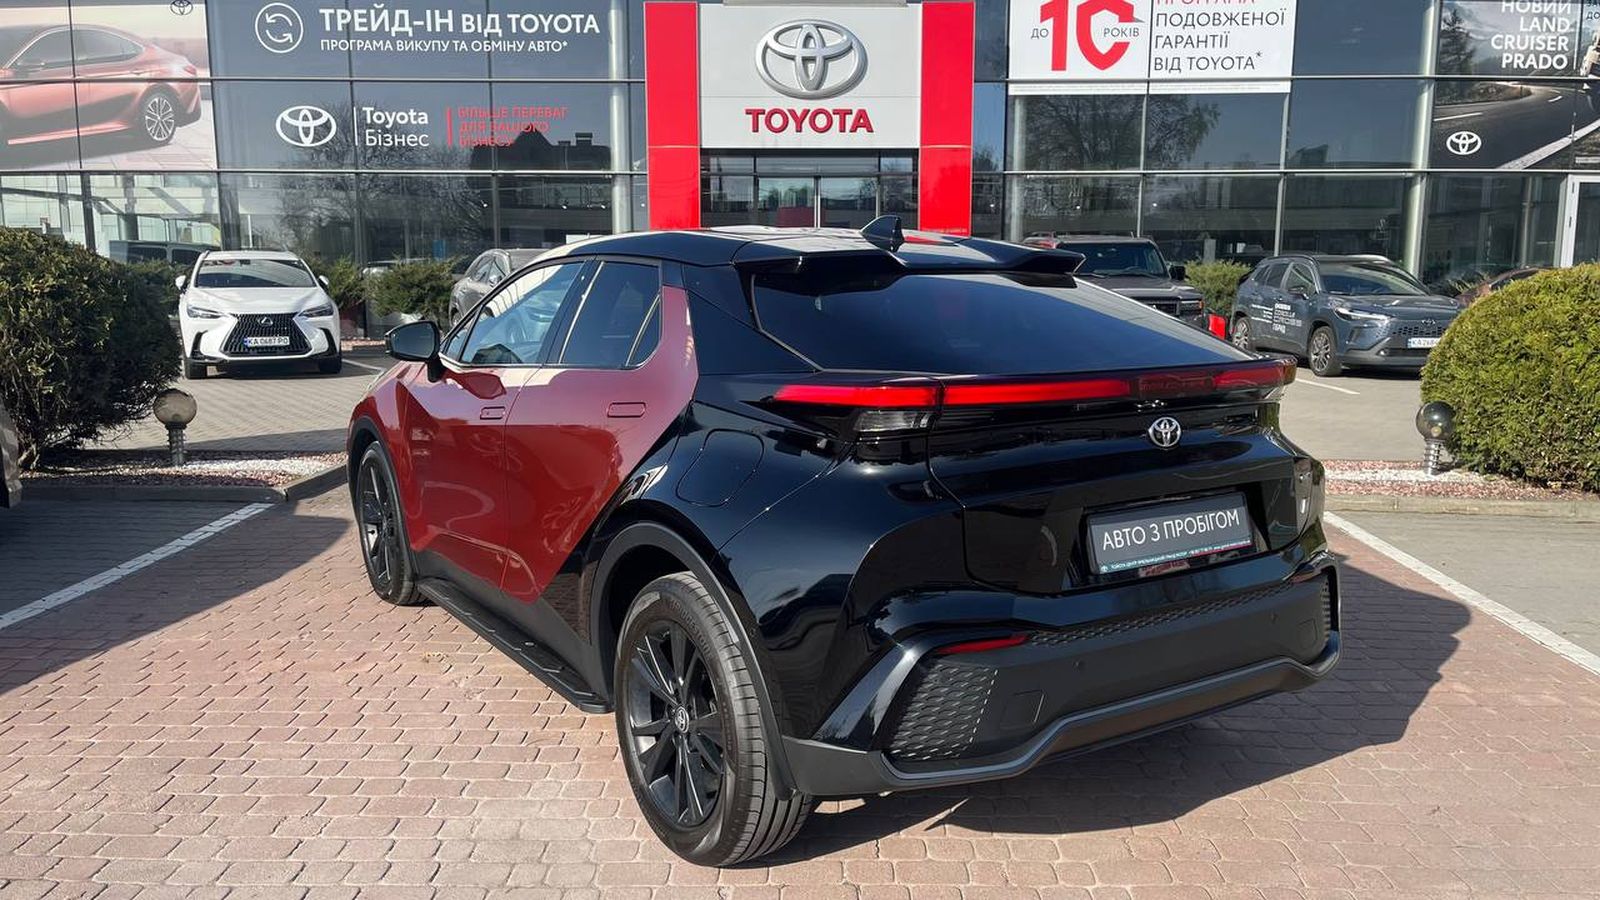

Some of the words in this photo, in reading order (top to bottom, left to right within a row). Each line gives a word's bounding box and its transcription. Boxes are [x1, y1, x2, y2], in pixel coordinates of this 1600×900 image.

[319, 3, 453, 37] ТРЕЙД-ІН
[462, 13, 502, 38] ВІД
[507, 13, 600, 34] TOYOTA
[1155, 8, 1286, 29] ПОДОВЖЕНОЇ
[1519, 17, 1570, 32] LAND
[1031, 28, 1049, 39] ДО
[1103, 27, 1139, 38] РОКІВ
[1154, 31, 1230, 49] ГАРАНТІЇ
[320, 39, 393, 51] ПРОГРАМА
[396, 40, 450, 52] ВИКУПУ
[453, 40, 468, 52] ТА
[471, 40, 525, 52] ОБМІНУ
[1491, 34, 1569, 51] CRUISER
[1154, 57, 1181, 73] ВІД
[1501, 53, 1568, 70] PRADO
[362, 107, 429, 128] Toyota
[745, 108, 874, 133] TOYOTA
[365, 130, 429, 147] Бізнес
[1103, 526, 1146, 550] АВТО
[1163, 509, 1240, 539] ПРОБІГОМ
